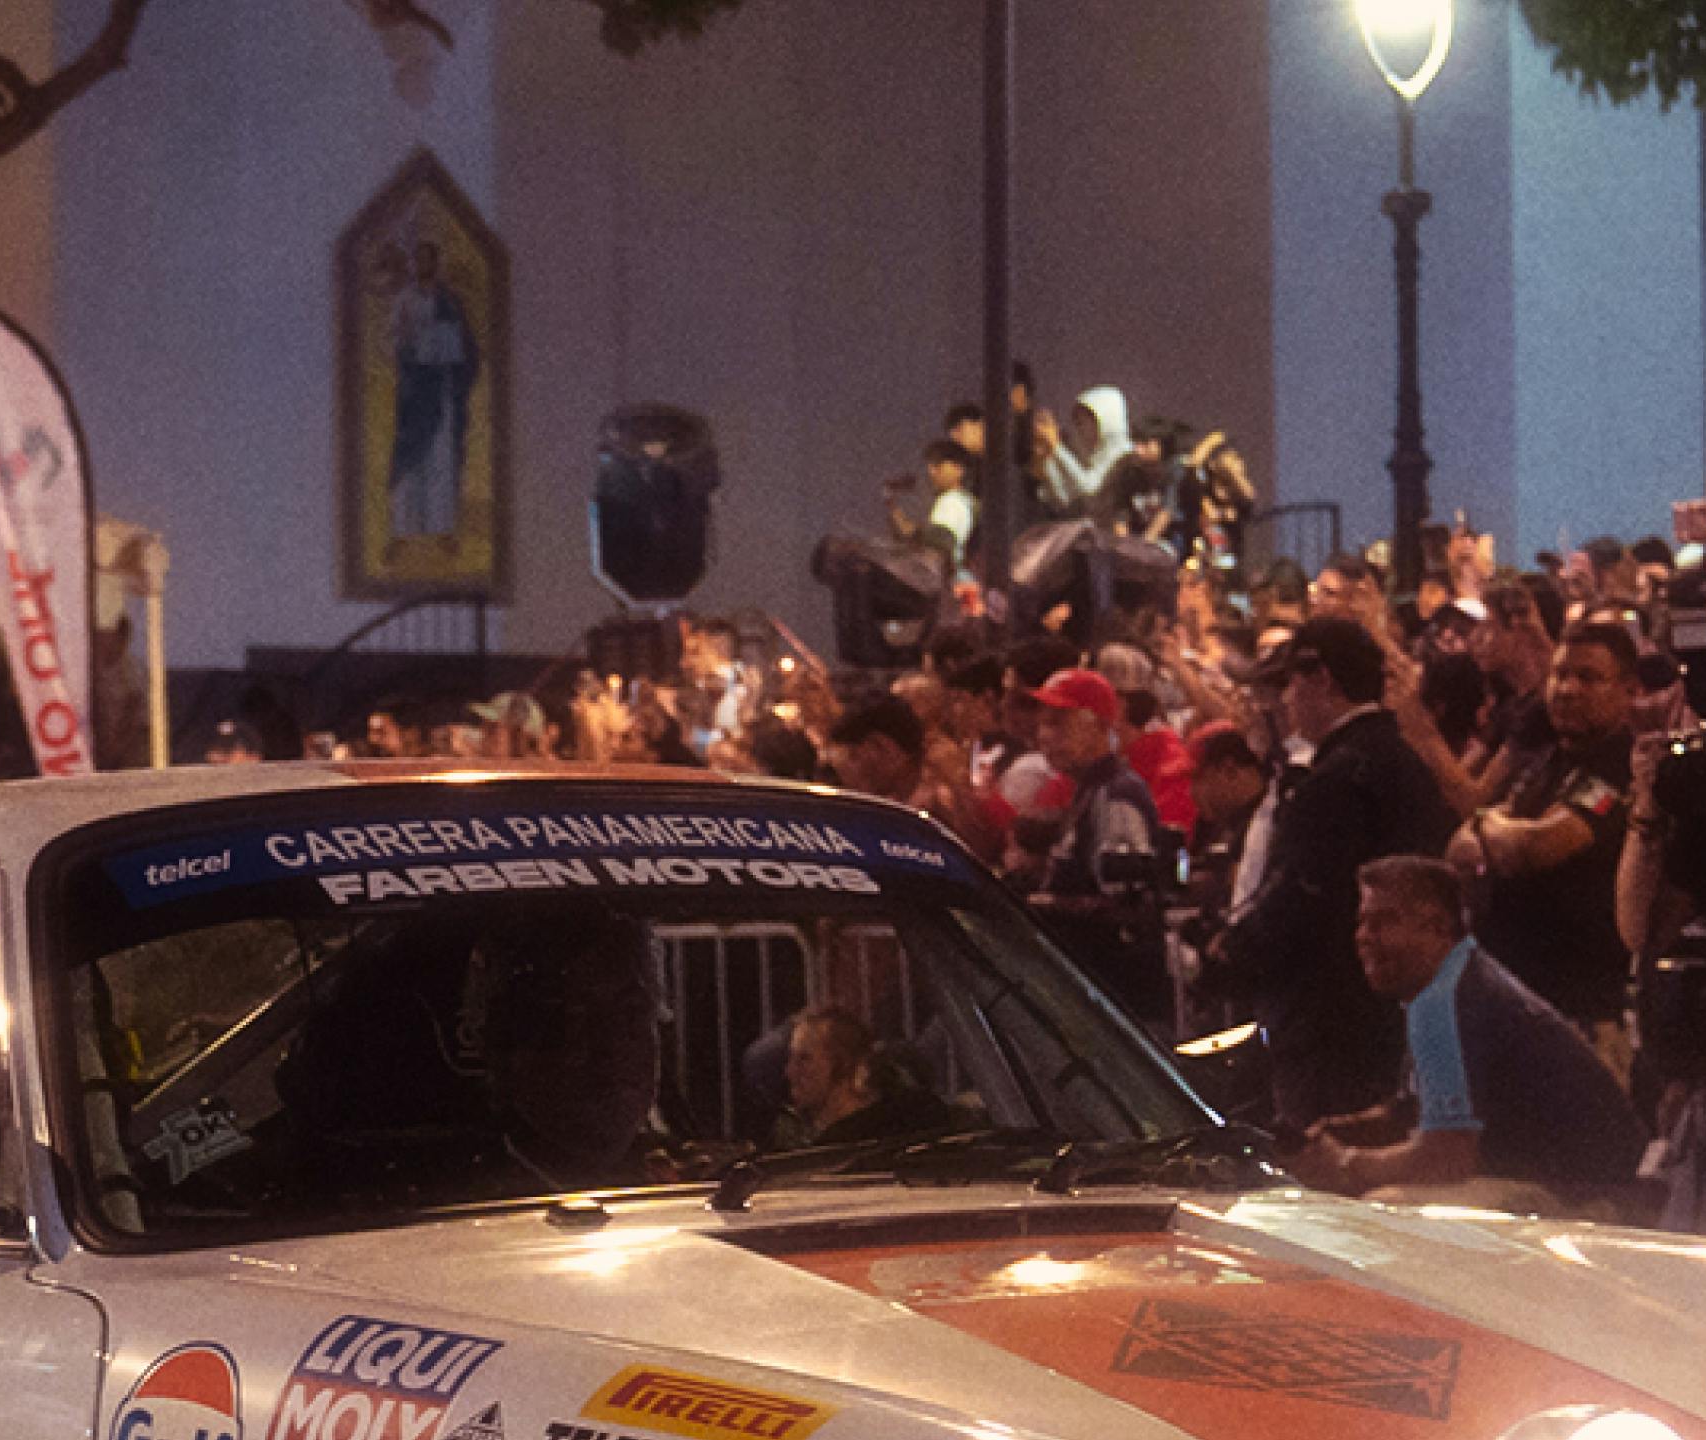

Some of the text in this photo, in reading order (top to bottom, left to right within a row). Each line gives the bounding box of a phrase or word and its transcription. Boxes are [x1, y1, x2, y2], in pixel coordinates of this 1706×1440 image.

[145, 849, 231, 887] telcel
[264, 816, 511, 868] CARRERA
[504, 812, 866, 857] PANAMERICANA
[317, 857, 882, 905] FARBEN MOTORS
[304, 1318, 495, 1394] LIQUI
[605, 1371, 819, 1440] PIRELLI
